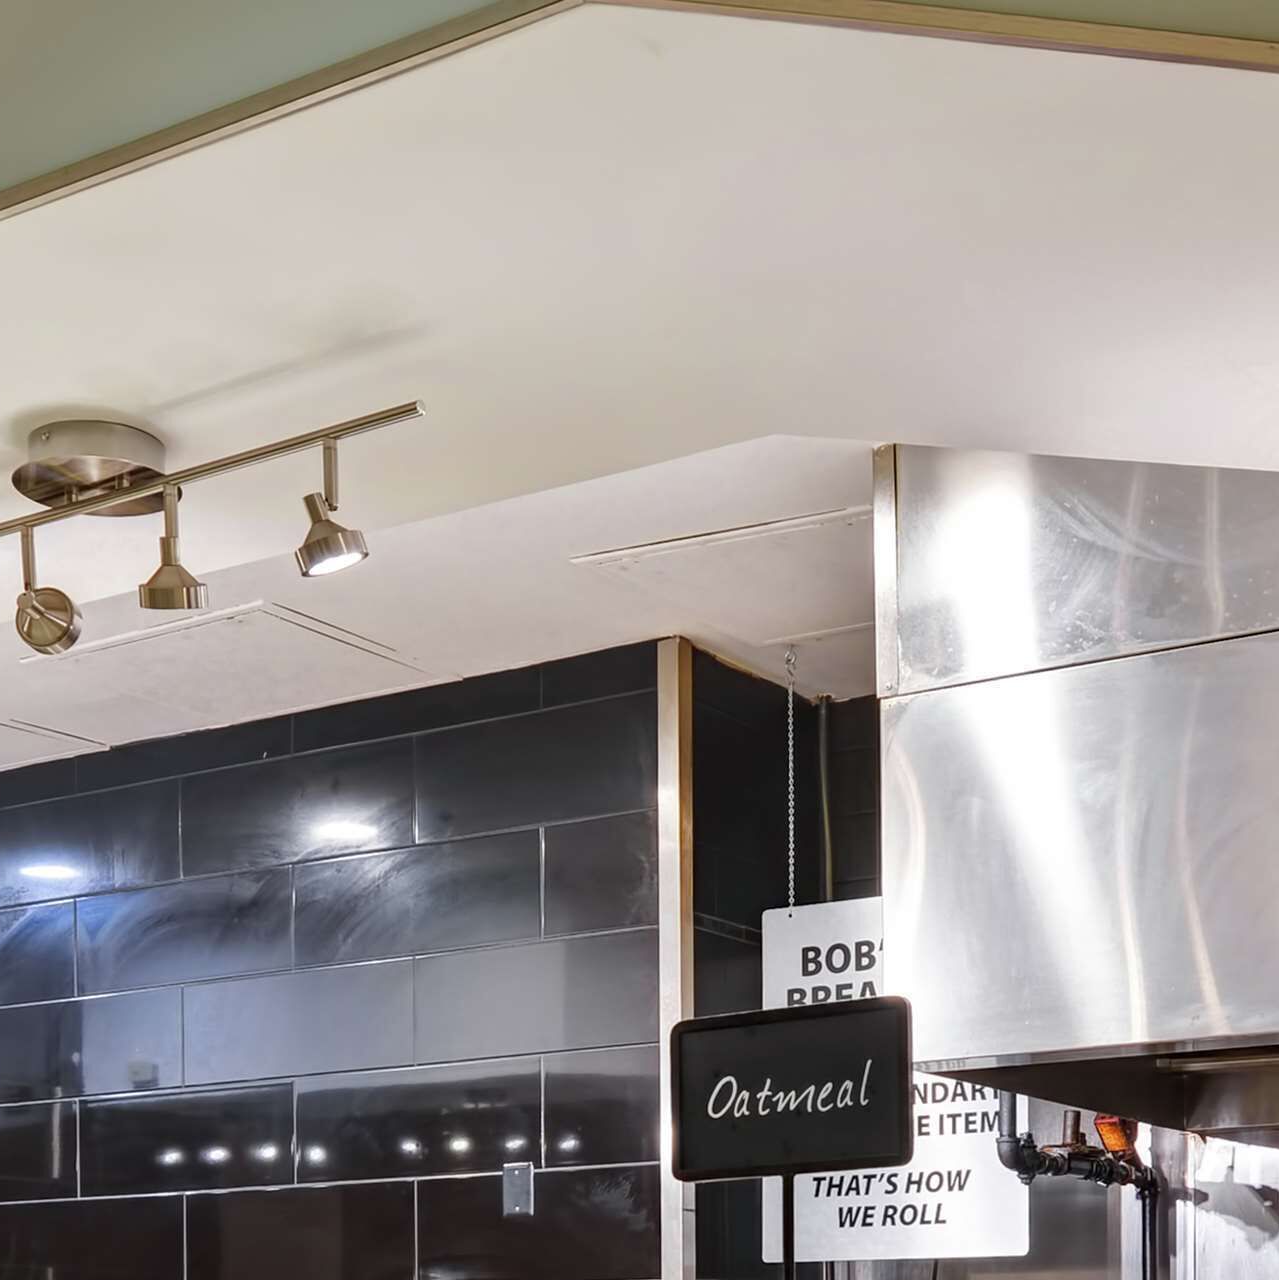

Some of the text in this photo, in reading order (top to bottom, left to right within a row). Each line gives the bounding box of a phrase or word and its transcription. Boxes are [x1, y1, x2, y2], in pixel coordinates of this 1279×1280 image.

[706, 1059, 873, 1119] Oatmeal
[812, 1169, 972, 1198] THAT'S HOW
[837, 1202, 947, 1228] WE ROLL
